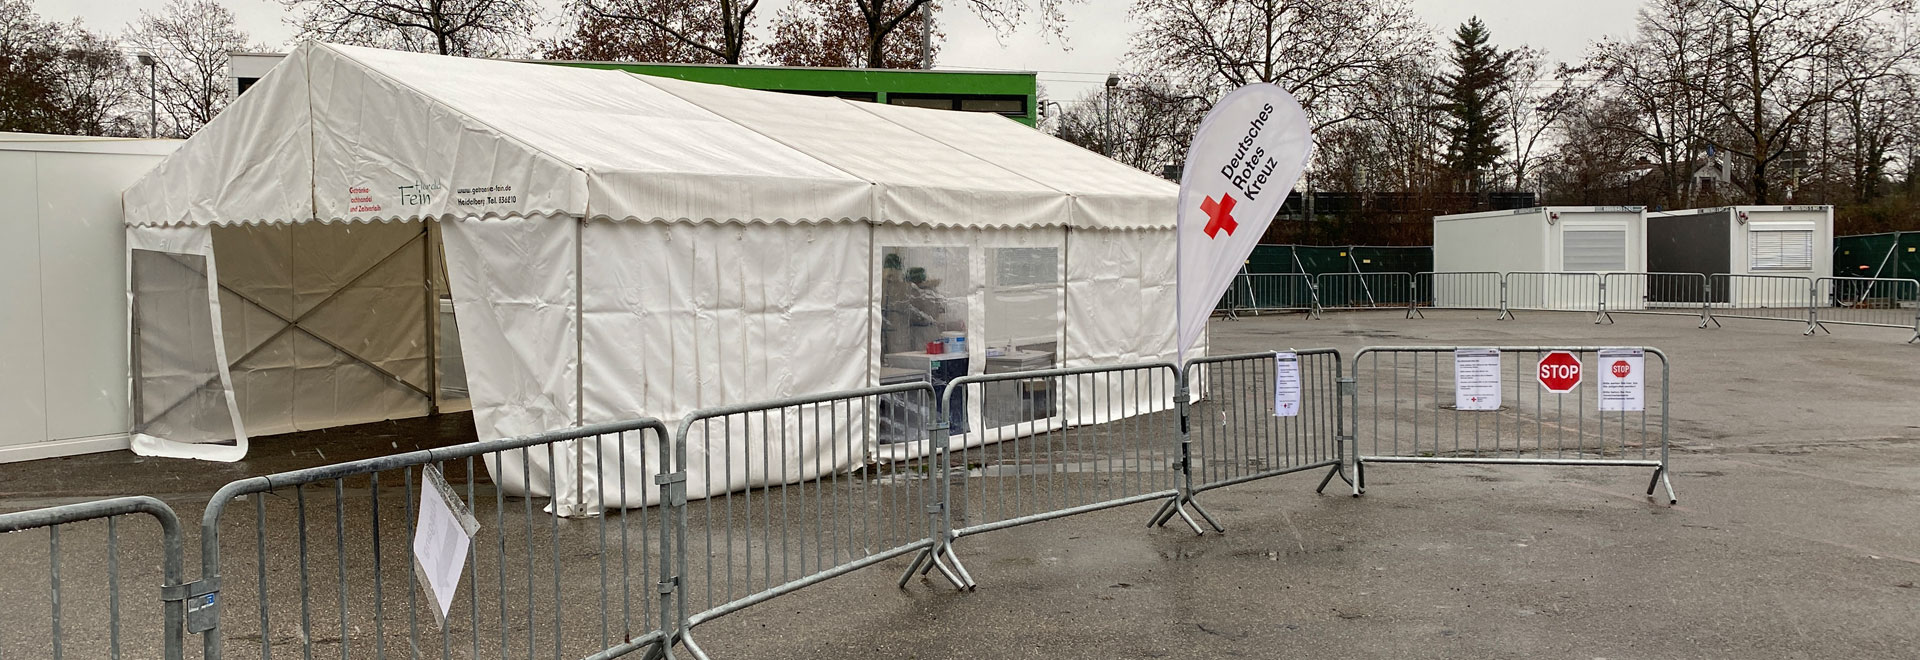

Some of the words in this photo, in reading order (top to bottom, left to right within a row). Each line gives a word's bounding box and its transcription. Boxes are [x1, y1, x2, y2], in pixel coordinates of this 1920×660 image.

[1221, 102, 1274, 180] Deutsches
[1232, 146, 1265, 191] Rotes
[1244, 156, 1278, 201] Kreuz
[398, 185, 431, 206] Fein
[487, 196, 497, 204] Tel.
[1541, 364, 1579, 380] STOP
[1613, 365, 1630, 373] STOP
